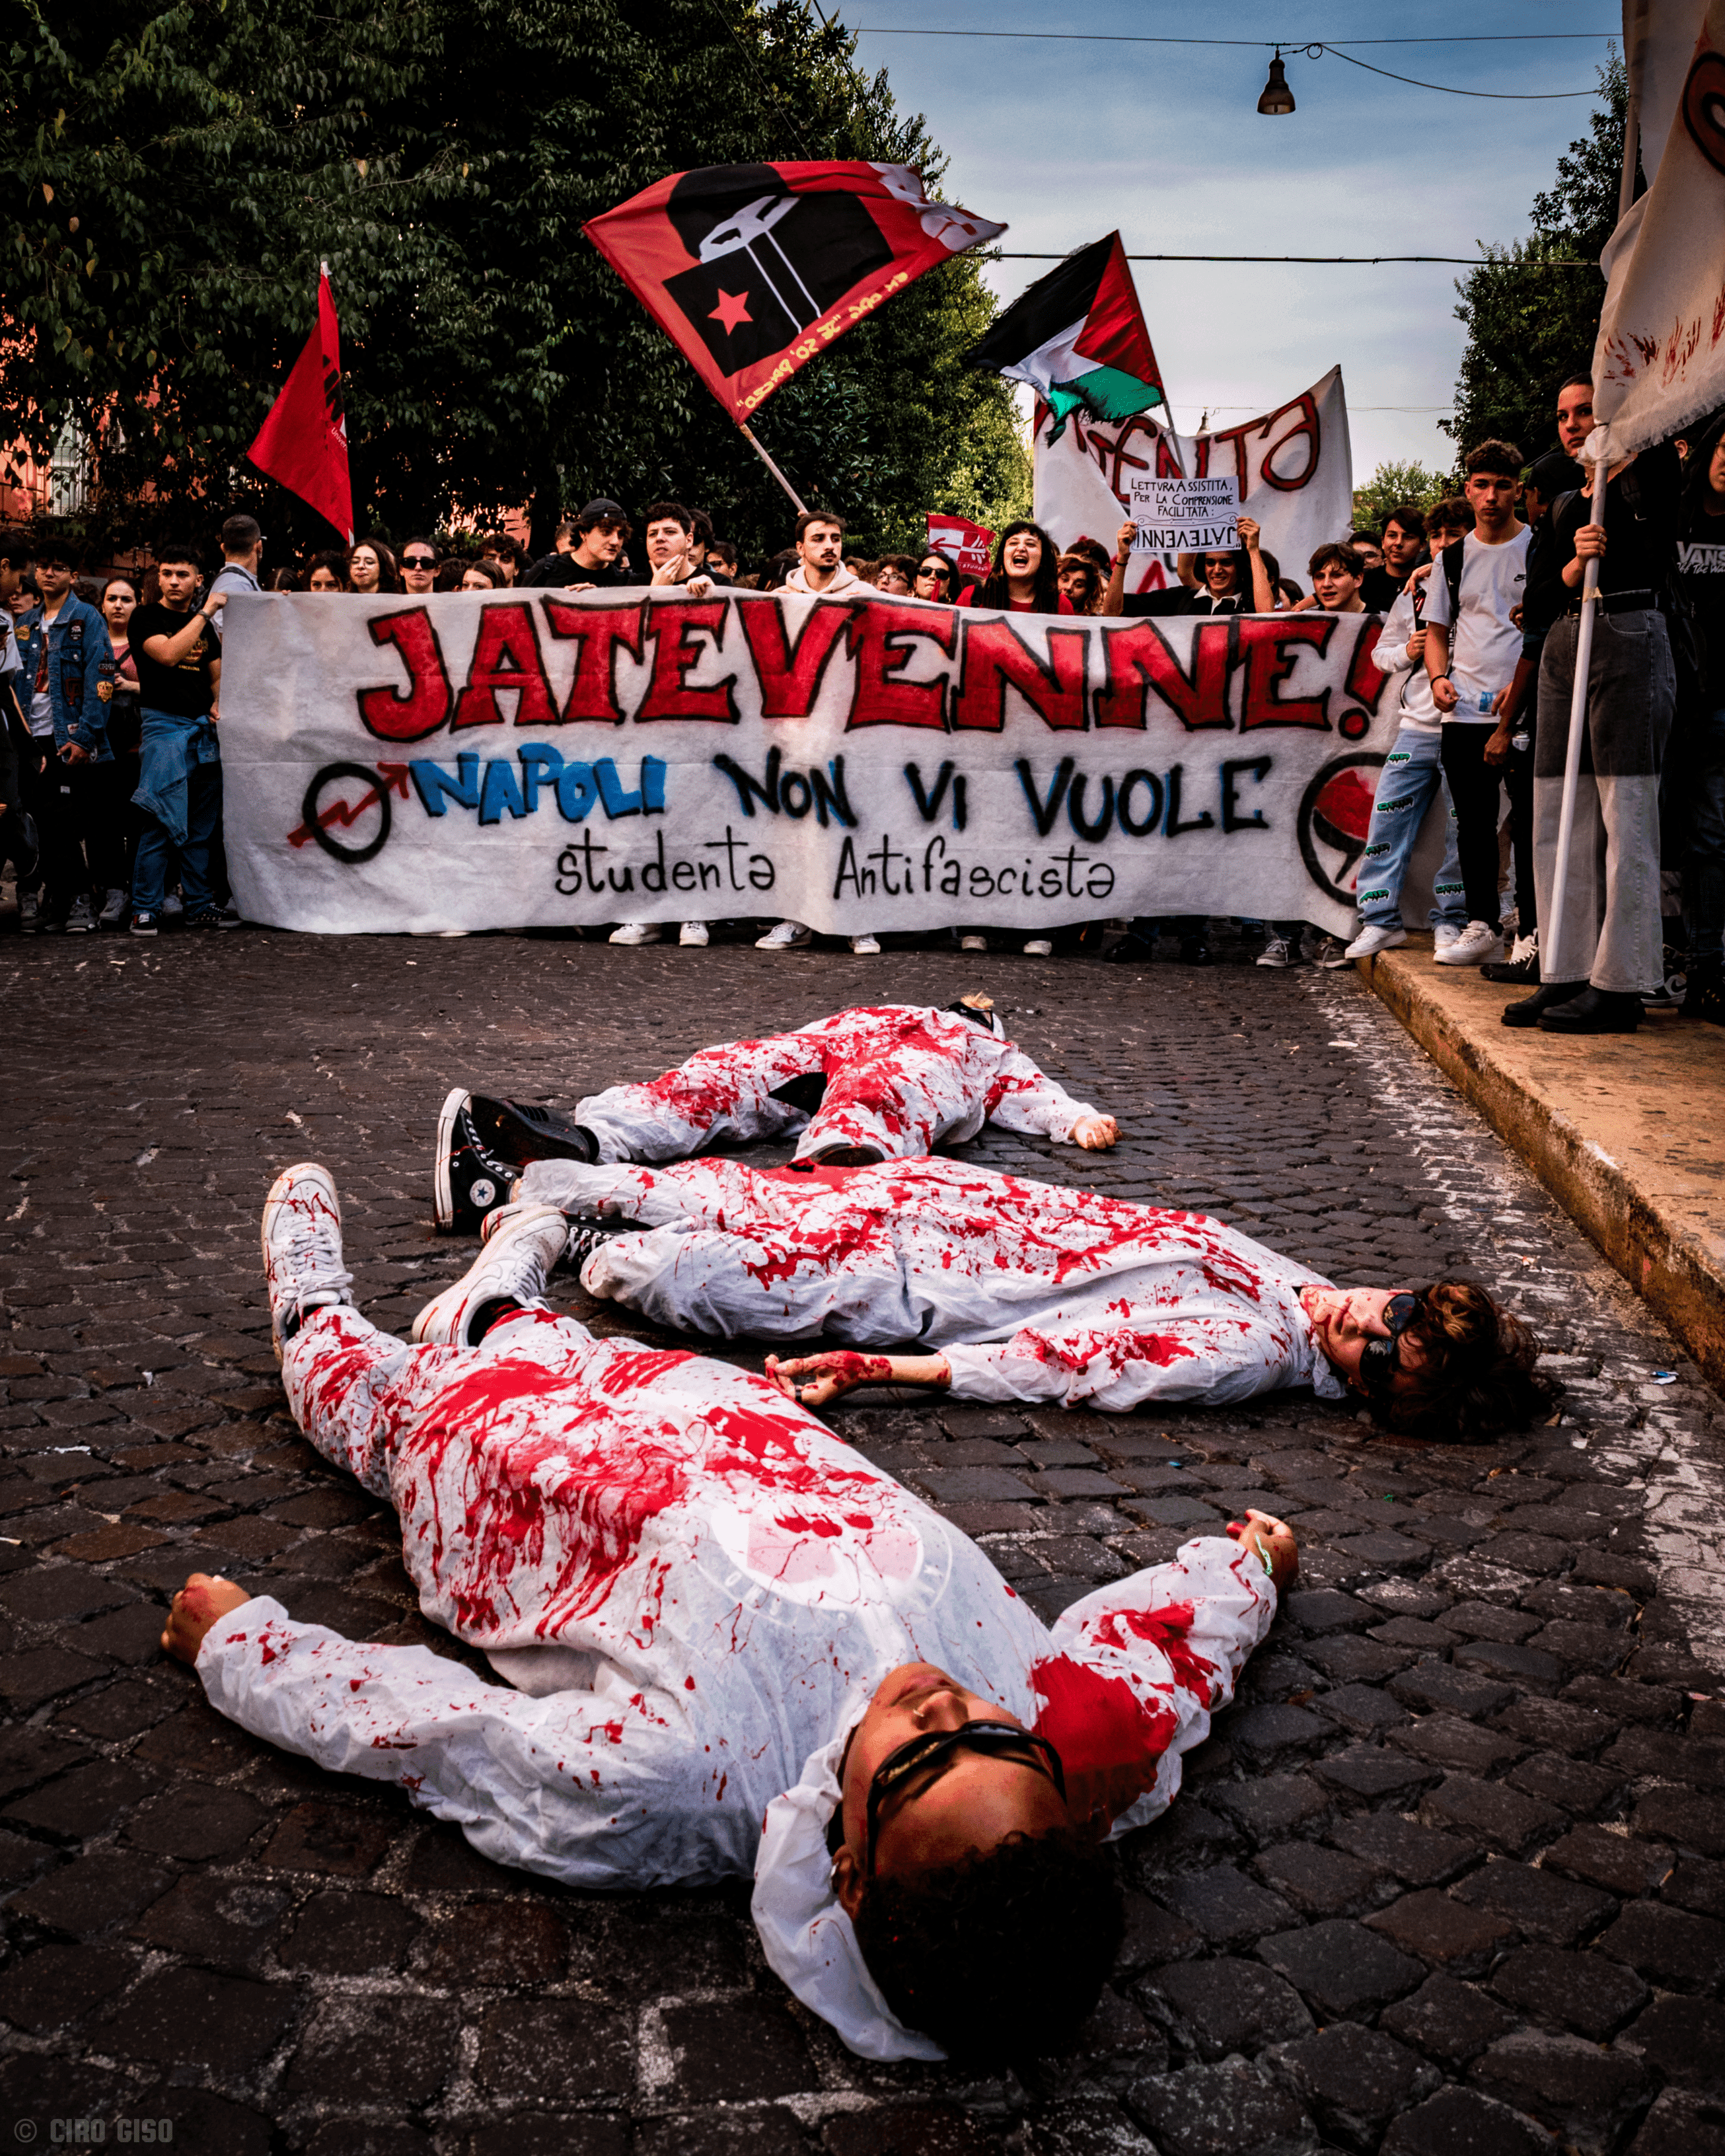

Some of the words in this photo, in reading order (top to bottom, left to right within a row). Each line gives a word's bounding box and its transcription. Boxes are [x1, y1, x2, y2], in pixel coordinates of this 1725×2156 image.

[1134, 491, 1150, 503] PER
[1156, 493, 1167, 504] LA
[1172, 493, 1233, 506] COMPRENSIONE
[1676, 540, 1725, 567] VANS
[357, 594, 1389, 742] JATEVENNE!
[409, 742, 667, 826] NAPOLI
[713, 745, 858, 831] NON
[903, 759, 968, 831] VI
[1014, 755, 1272, 842] VUOLE
